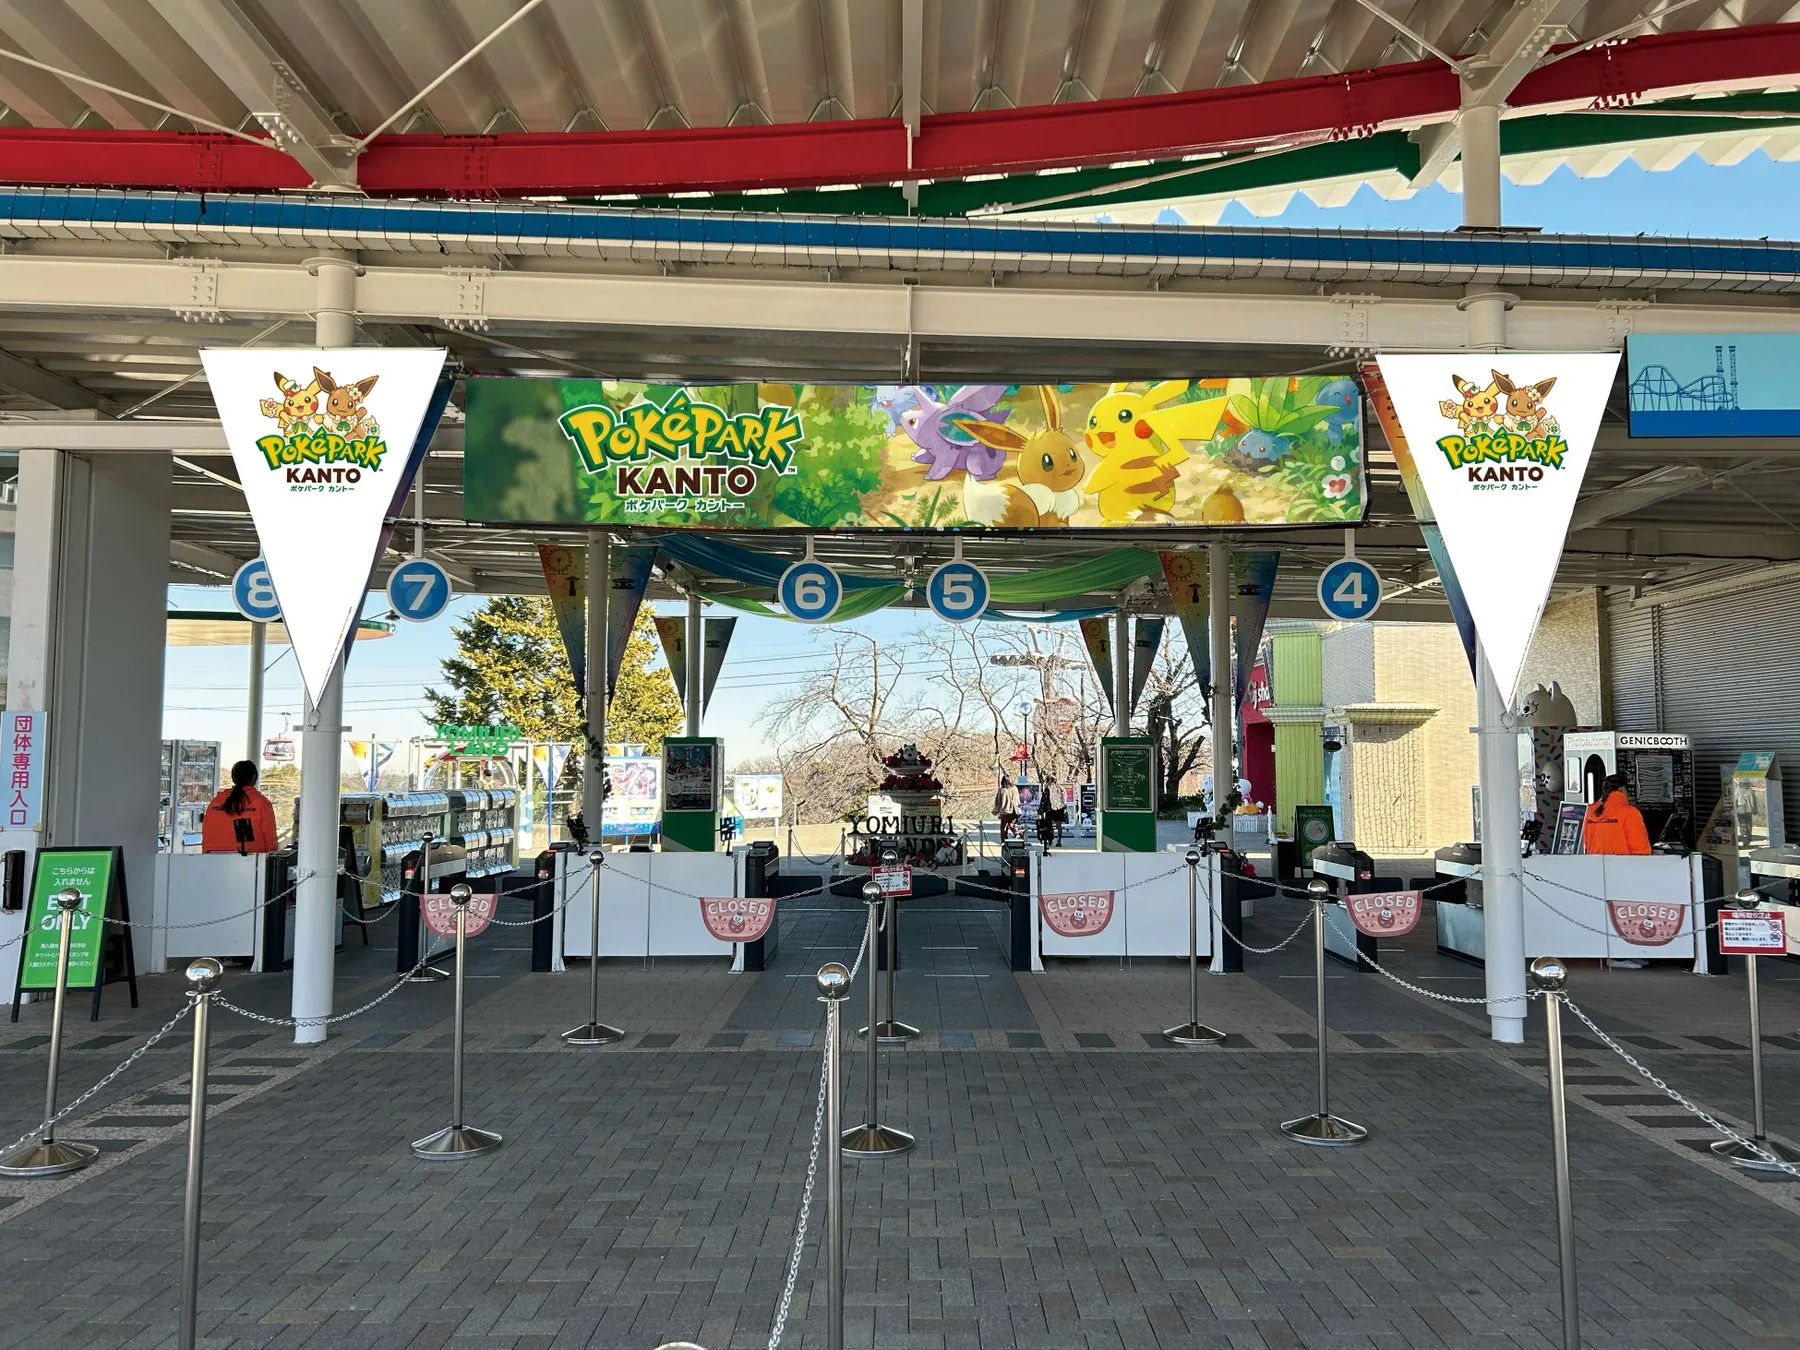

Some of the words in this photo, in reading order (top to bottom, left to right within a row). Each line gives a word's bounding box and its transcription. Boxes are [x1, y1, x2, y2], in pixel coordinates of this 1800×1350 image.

[286, 467, 361, 484] KANTO
[618, 466, 755, 495] KANTO
[1468, 466, 1544, 482] KANTO
[290, 485, 325, 493] ポケパーク
[328, 485, 355, 493] カントー
[1472, 483, 1508, 491] ポケパーク
[1511, 483, 1538, 491] カントー
[624, 499, 689, 513] ポケパーク
[696, 499, 746, 512] カントー
[247, 571, 278, 608] 8
[402, 574, 436, 611] 7
[795, 573, 826, 610] 6
[942, 573, 974, 610] 5
[1333, 572, 1368, 608] 4
[434, 723, 520, 741] YOMIURI
[449, 740, 509, 757] LAND
[1620, 736, 1688, 746] GENICBOOTH
[9, 716, 33, 825] 団体専用入口
[847, 815, 954, 835] YOMIURI
[52, 866, 95, 875] こちらからは
[54, 878, 91, 886] 入れません
[708, 900, 768, 916] CLOSED
[1047, 895, 1108, 913] CLOSED
[1353, 895, 1416, 913] CLOSED
[1617, 904, 1678, 921] CLOSED
